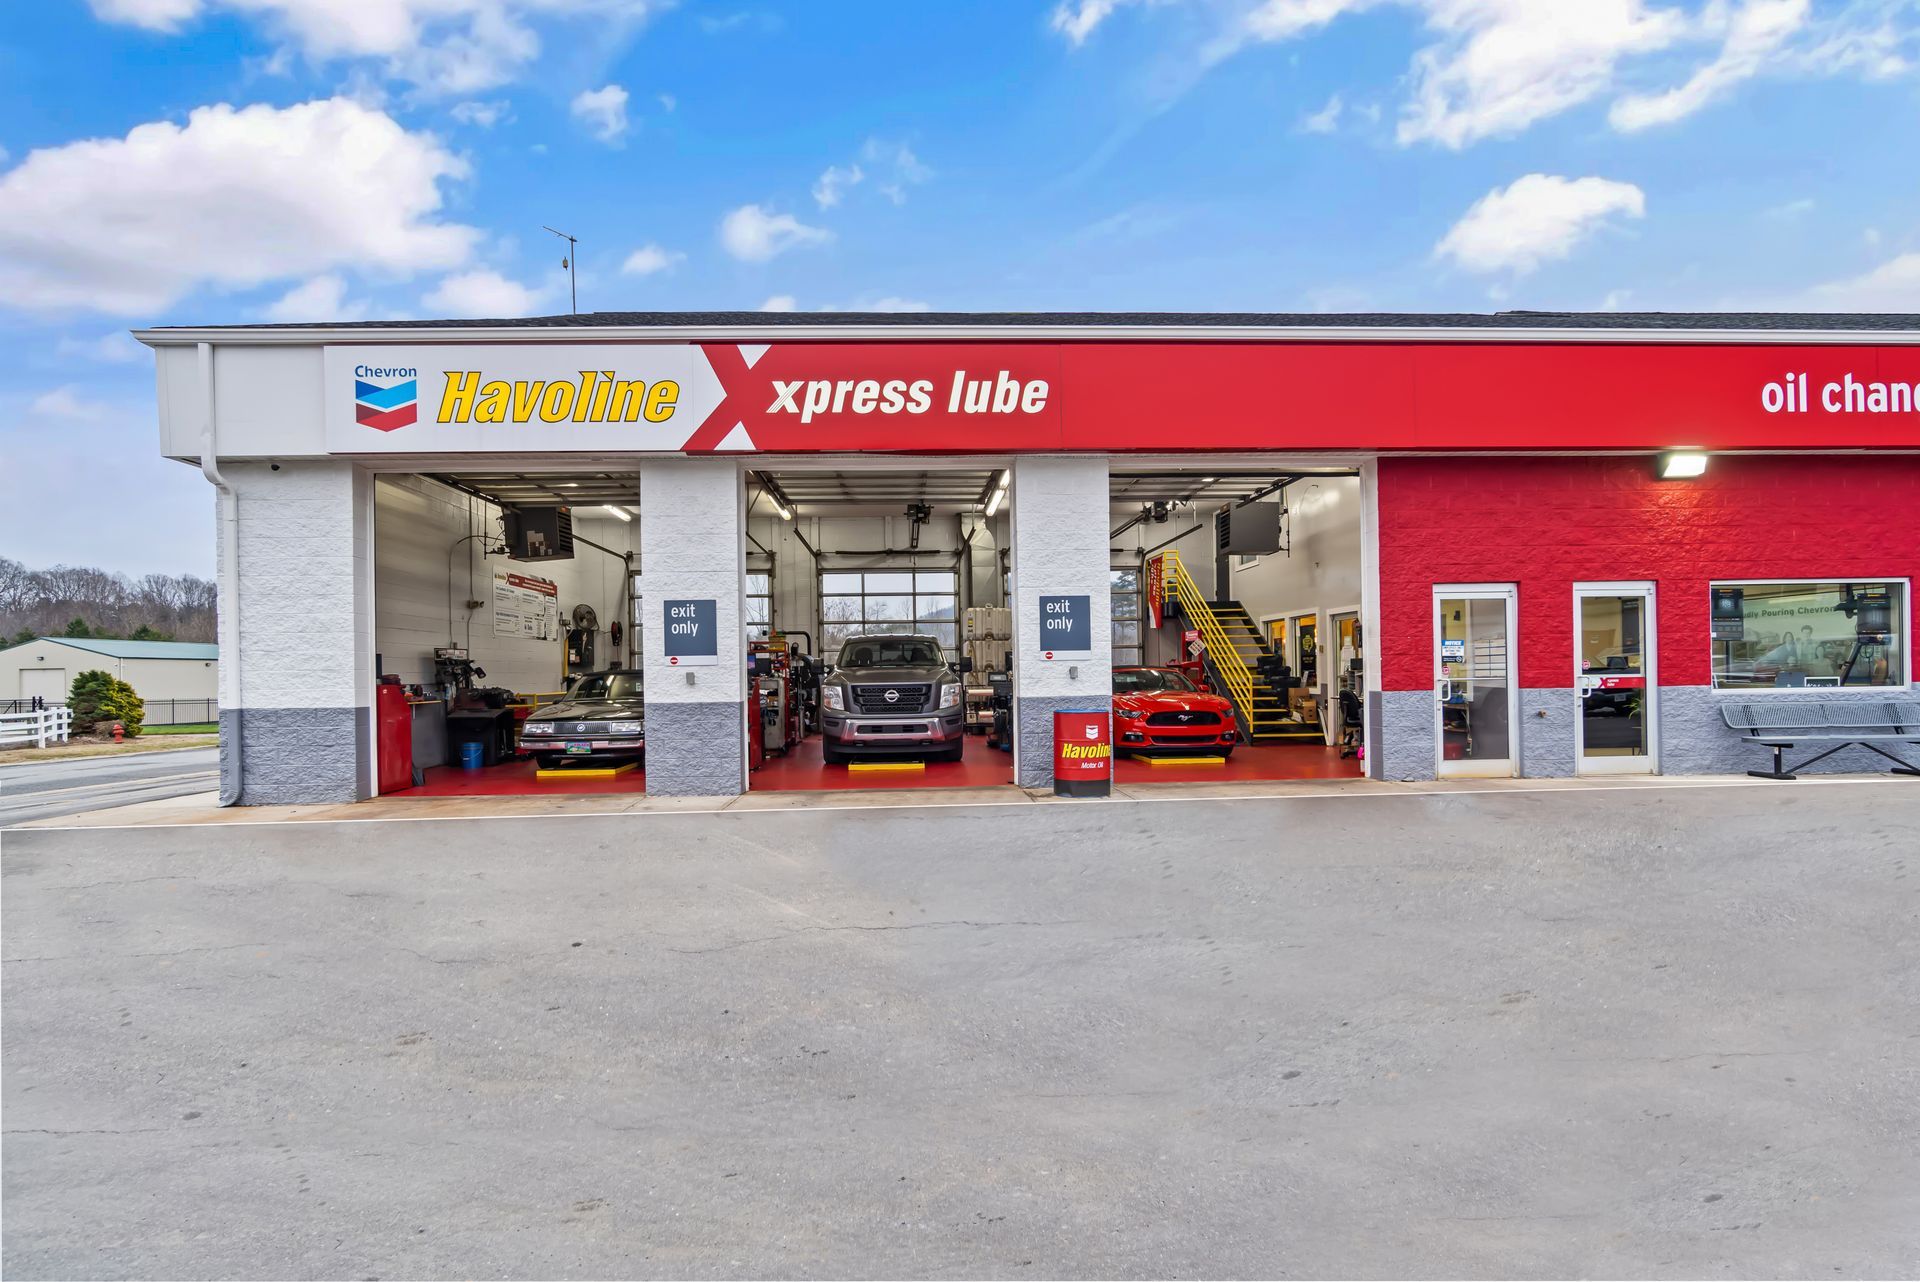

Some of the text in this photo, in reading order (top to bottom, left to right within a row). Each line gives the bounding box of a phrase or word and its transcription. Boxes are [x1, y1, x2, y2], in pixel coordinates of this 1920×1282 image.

[355, 365, 417, 378] Chevron
[436, 371, 680, 423] Havoline
[766, 380, 934, 424] xpress
[948, 370, 1049, 414] lube
[1761, 372, 1808, 413] oil
[671, 603, 696, 618] exit
[1046, 599, 1071, 613] exit
[1761, 604, 1795, 617] Pouring
[671, 620, 699, 637] only
[1046, 616, 1073, 632] only
